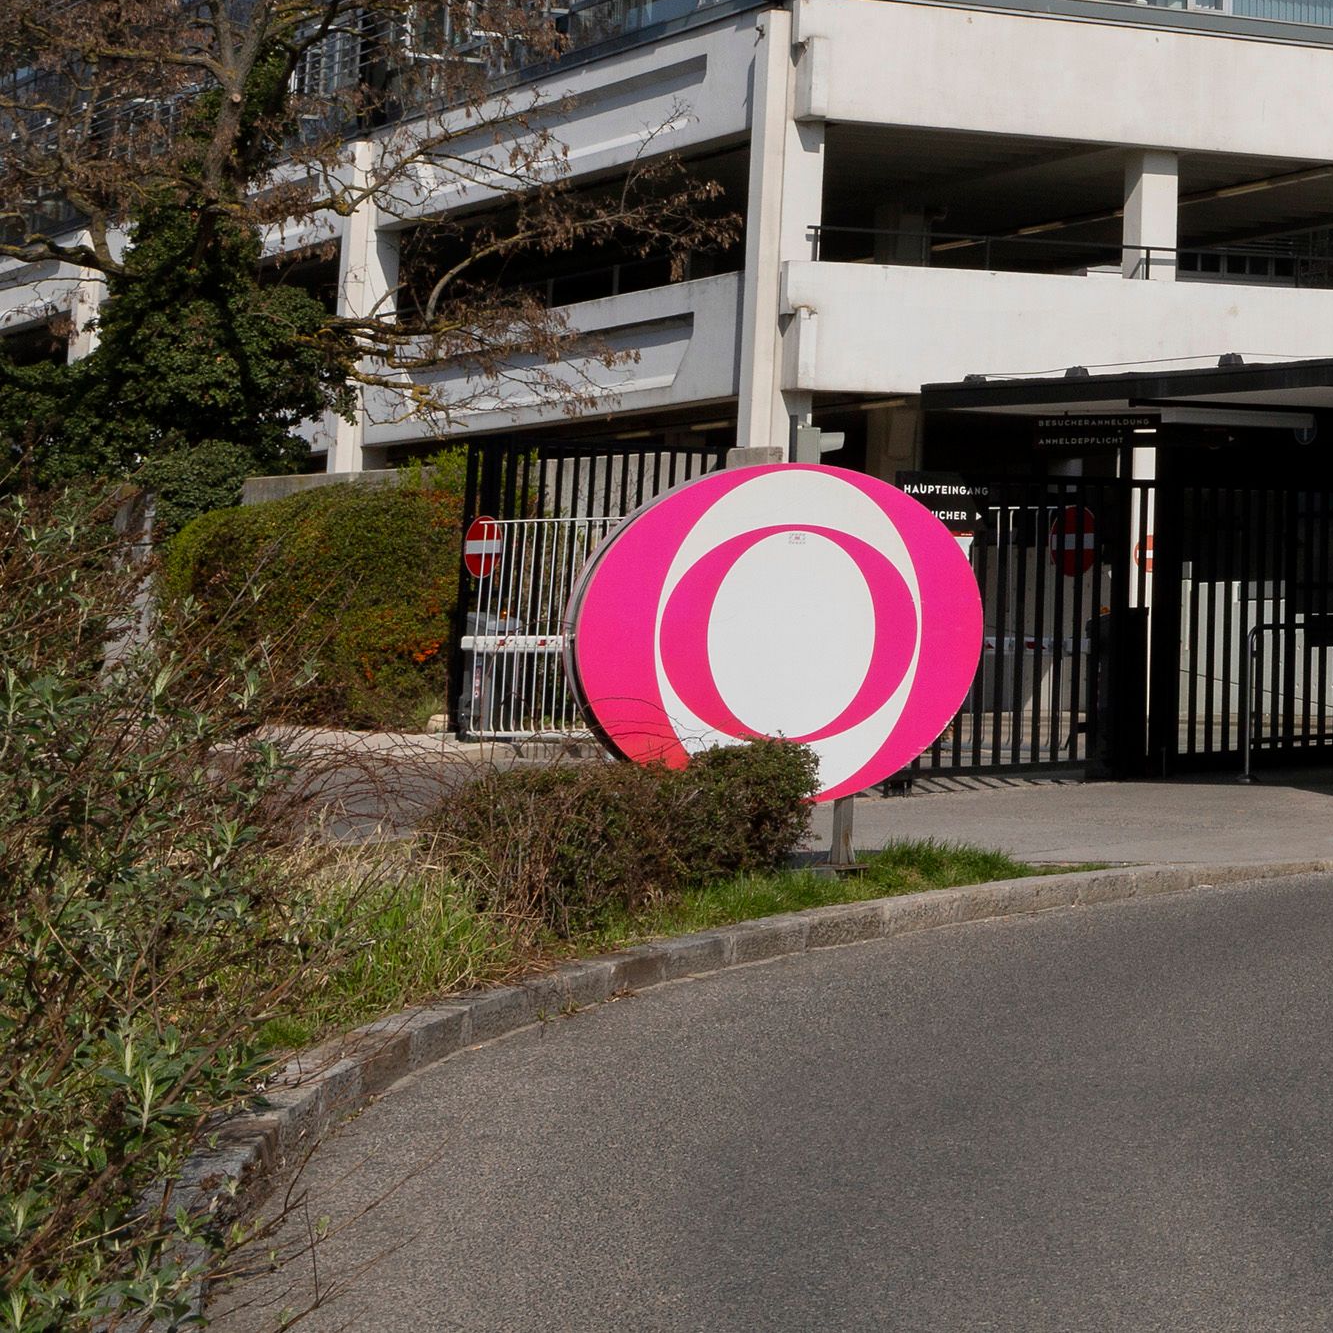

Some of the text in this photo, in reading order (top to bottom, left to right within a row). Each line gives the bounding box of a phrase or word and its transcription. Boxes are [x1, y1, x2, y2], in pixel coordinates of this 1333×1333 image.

[1038, 418, 1150, 427] BESUCHERANMELDUNG
[1038, 437, 1124, 445] ANMELDEPFLICHT
[904, 483, 989, 496] HAUPTEINGANG
[931, 510, 967, 520] UCHER
